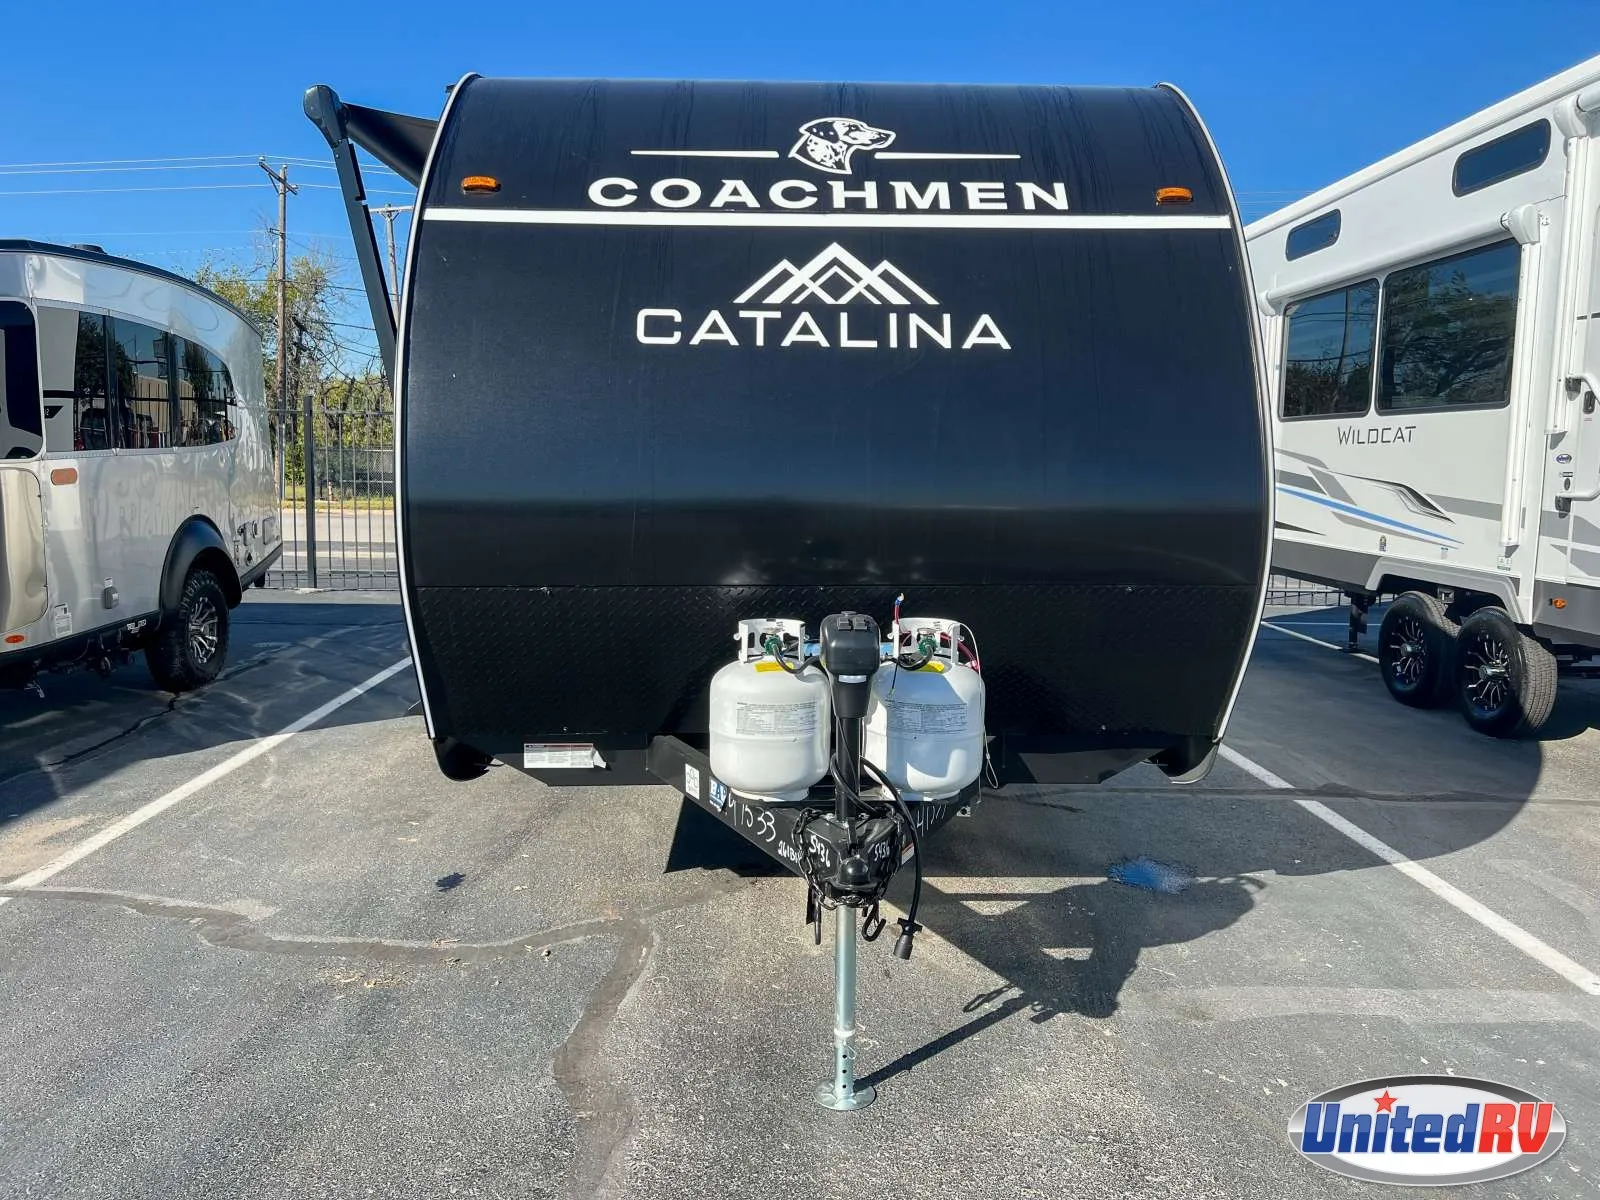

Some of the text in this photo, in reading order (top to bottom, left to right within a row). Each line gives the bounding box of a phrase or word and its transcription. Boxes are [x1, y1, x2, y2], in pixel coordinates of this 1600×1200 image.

[587, 177, 1069, 211] COACHMEN
[636, 308, 1012, 350] CATALINA
[1337, 425, 1417, 446] WILDCAT
[808, 834, 831, 868] 5436
